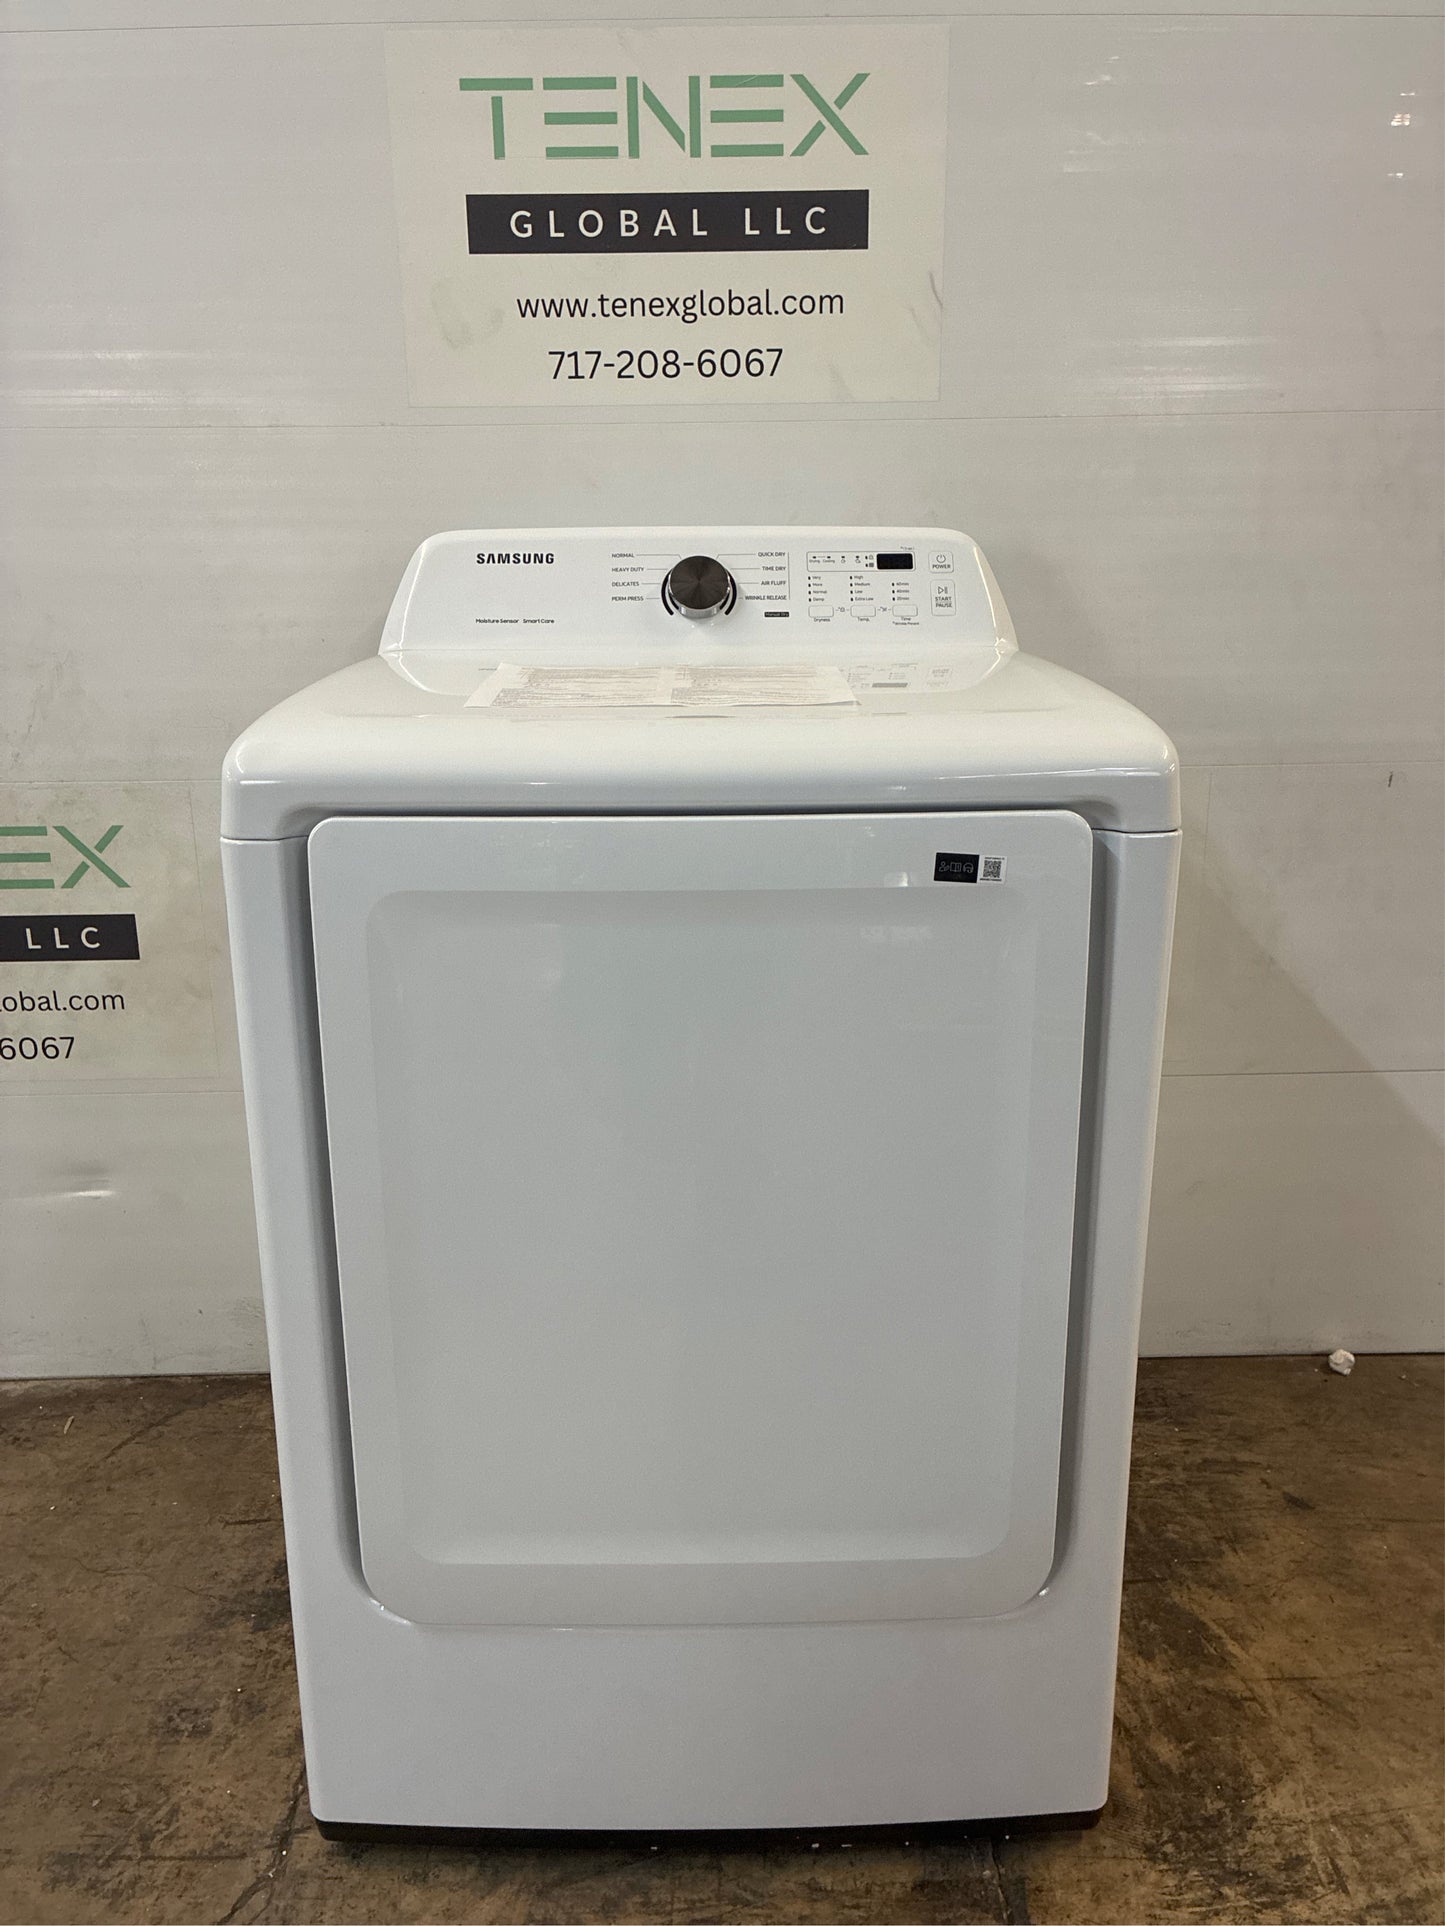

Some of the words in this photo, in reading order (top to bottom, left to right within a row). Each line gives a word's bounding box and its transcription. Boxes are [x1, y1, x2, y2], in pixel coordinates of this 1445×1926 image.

[459, 73, 871, 160] TENEX
[509, 208, 708, 239] GLOBAL
[744, 206, 828, 236] LLC
[516, 289, 845, 324] www.tenexglobal.com
[548, 348, 783, 380] 717-208-6067
[476, 553, 555, 565] SAMSUNG
[25, 926, 101, 950] LLC
[0, 990, 125, 1012] obal.com
[0, 1036, 75, 1060] 6067
